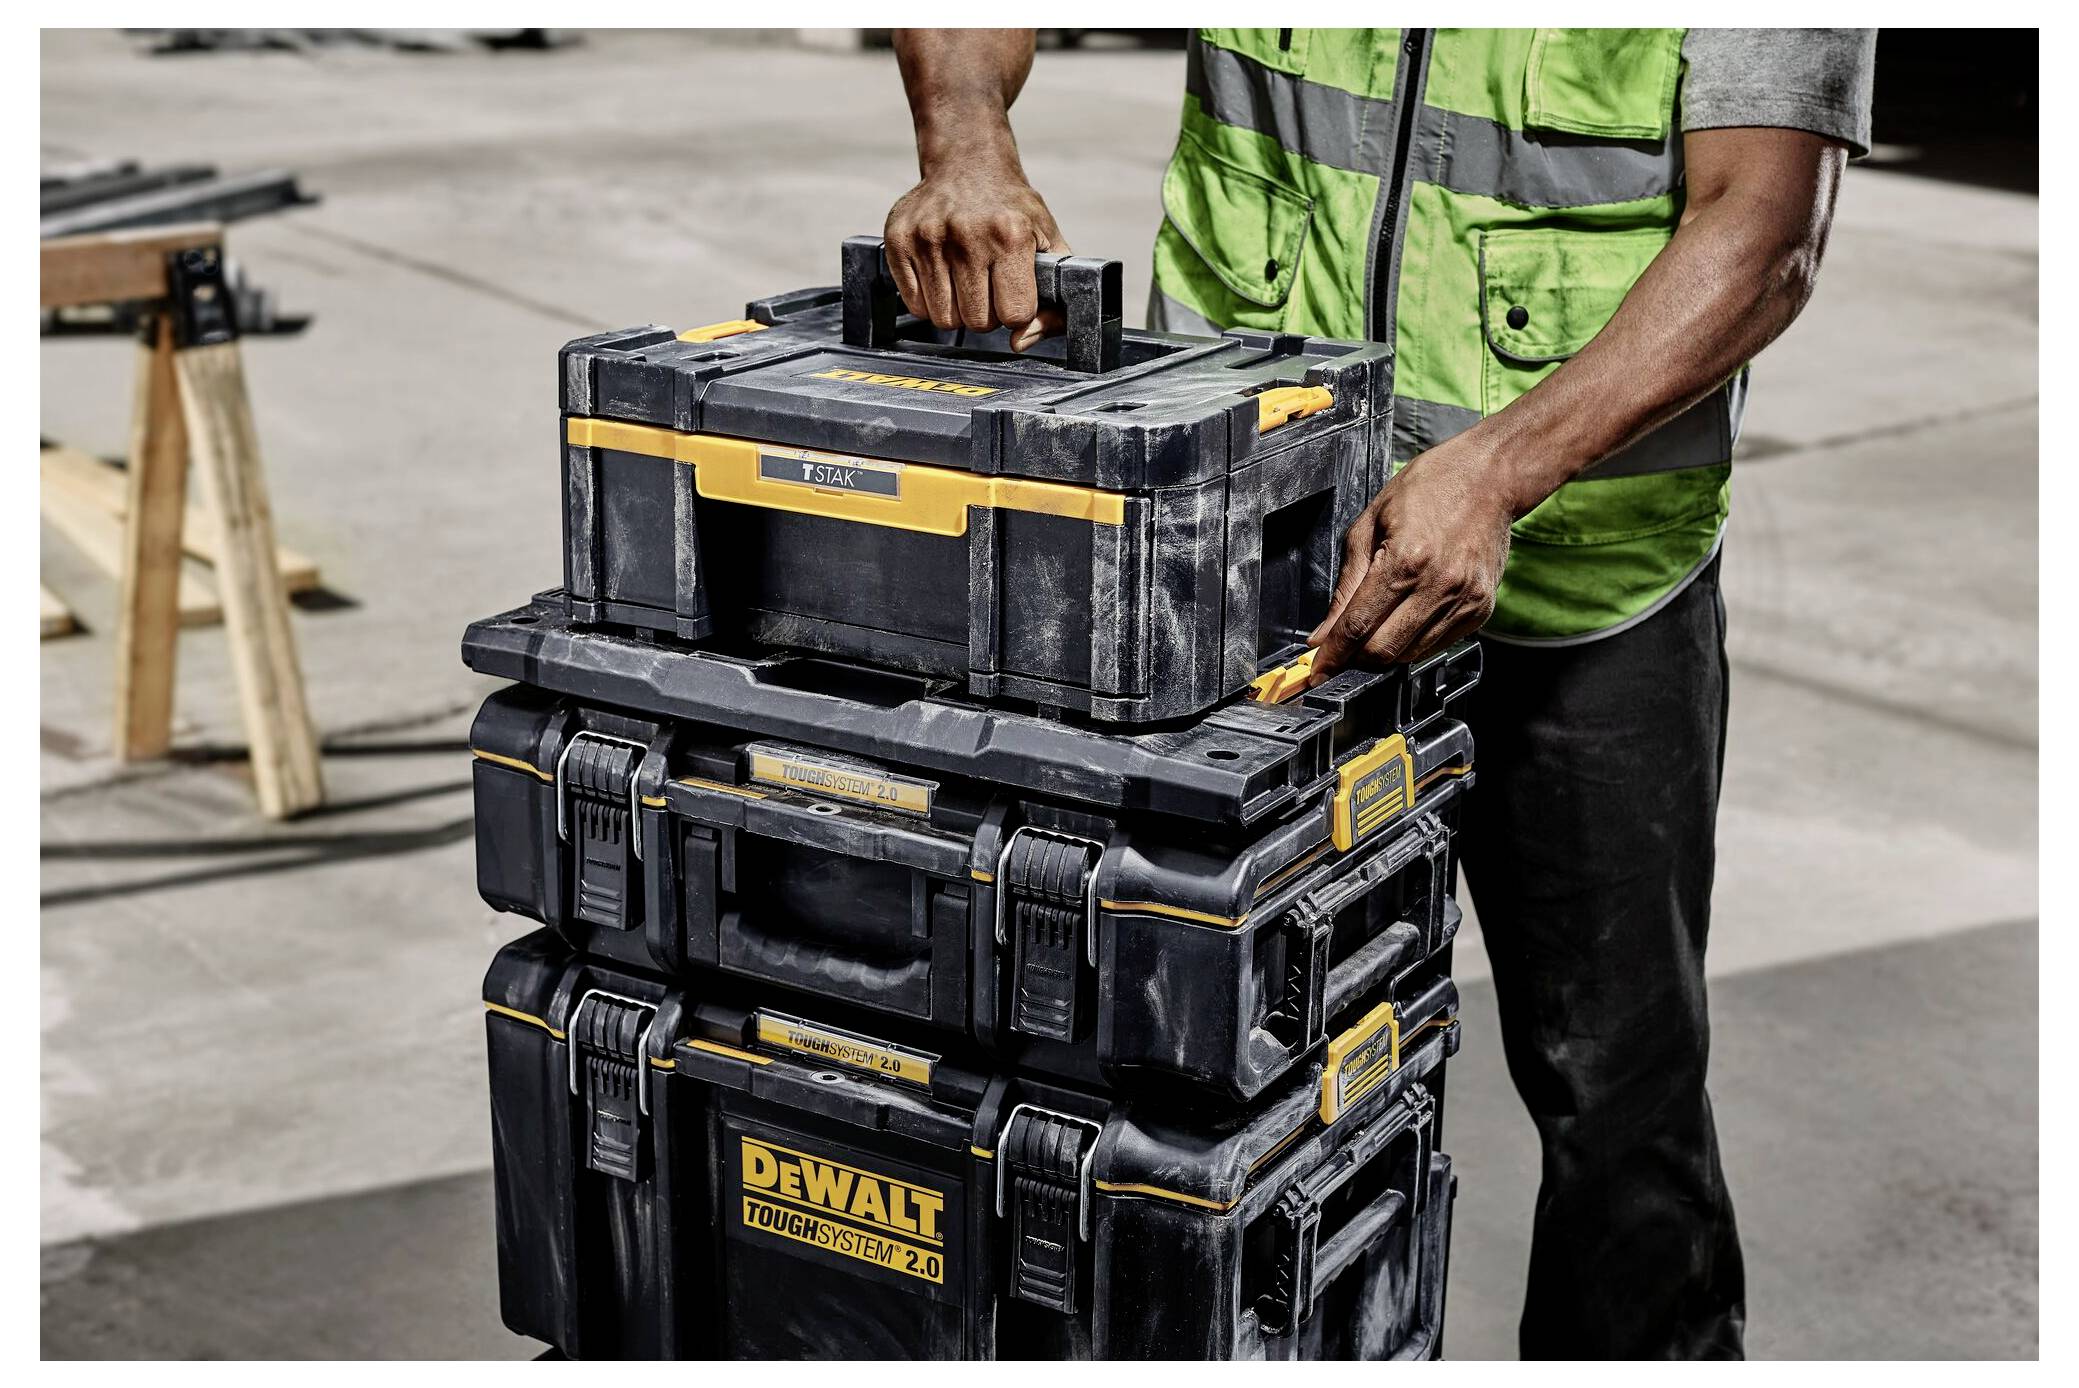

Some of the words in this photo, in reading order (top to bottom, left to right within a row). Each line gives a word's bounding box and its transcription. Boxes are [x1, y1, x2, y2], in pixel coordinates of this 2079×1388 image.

[877, 784, 898, 802] 2.0
[880, 1056, 901, 1072] 2.0
[905, 1250, 940, 1279] 2.0
